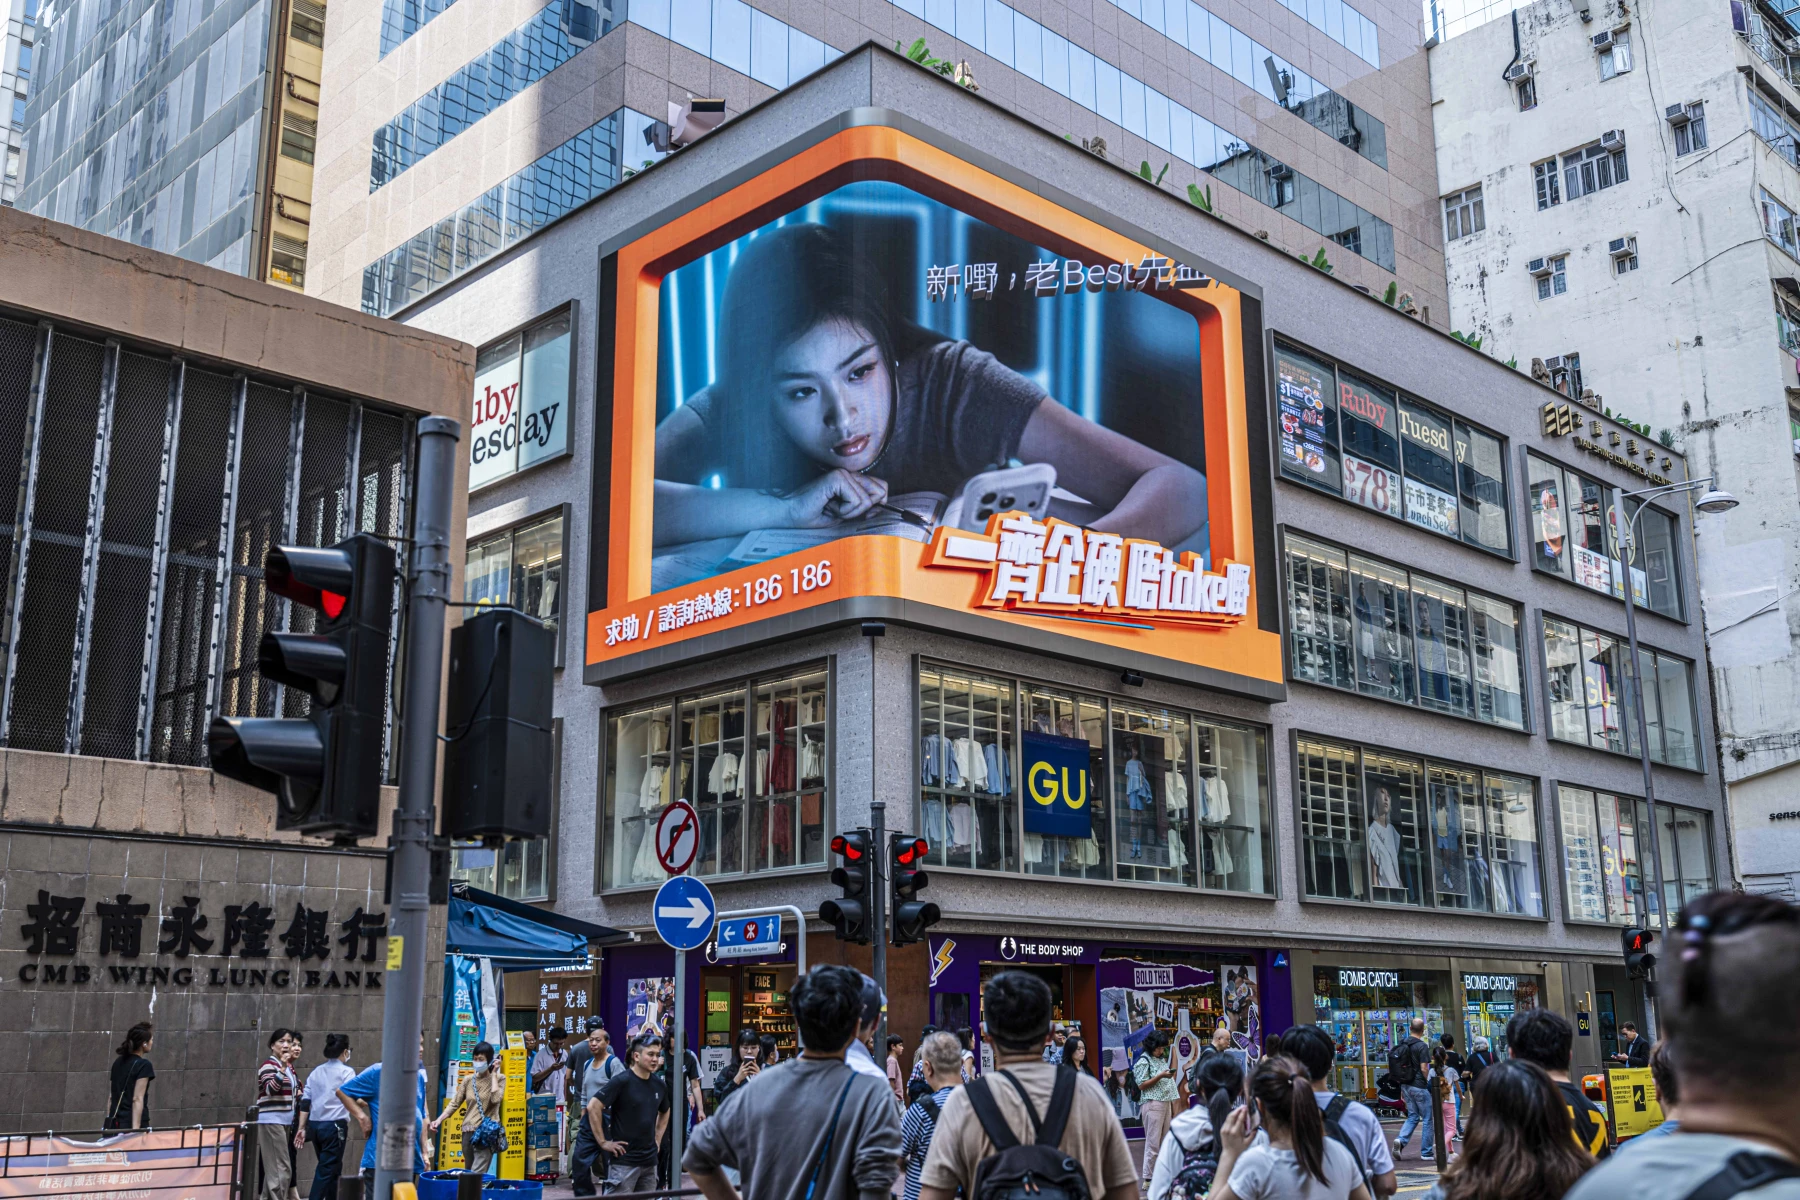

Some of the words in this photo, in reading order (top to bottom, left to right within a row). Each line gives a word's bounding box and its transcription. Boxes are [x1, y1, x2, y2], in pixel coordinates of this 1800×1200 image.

[1340, 383, 1387, 428] Ruby
[1398, 409, 1467, 463] Tuesdy
[1344, 457, 1389, 512] $78
[605, 614, 639, 646] 求助
[790, 560, 832, 595] 186
[1028, 760, 1087, 809] GU
[1602, 845, 1627, 878] GU
[21, 889, 388, 962] 招商永隆銀行
[1020, 943, 1037, 955] THE
[1038, 944, 1060, 956] BODY
[1061, 945, 1084, 957] SHOP
[18, 963, 92, 984] CMB
[107, 966, 193, 986] WING
[208, 968, 291, 988] LUNG
[304, 970, 384, 989] BANK
[754, 975, 771, 988] FACE
[1135, 970, 1152, 986] BOLD
[1152, 969, 1173, 985] THEN.
[1339, 970, 1367, 987] BOMB
[1368, 971, 1398, 988] CATCH
[1464, 974, 1489, 990] BOMB
[1489, 976, 1515, 990] CATCH
[1157, 999, 1174, 1018] IT'S
[1578, 1018, 1589, 1030] GU
